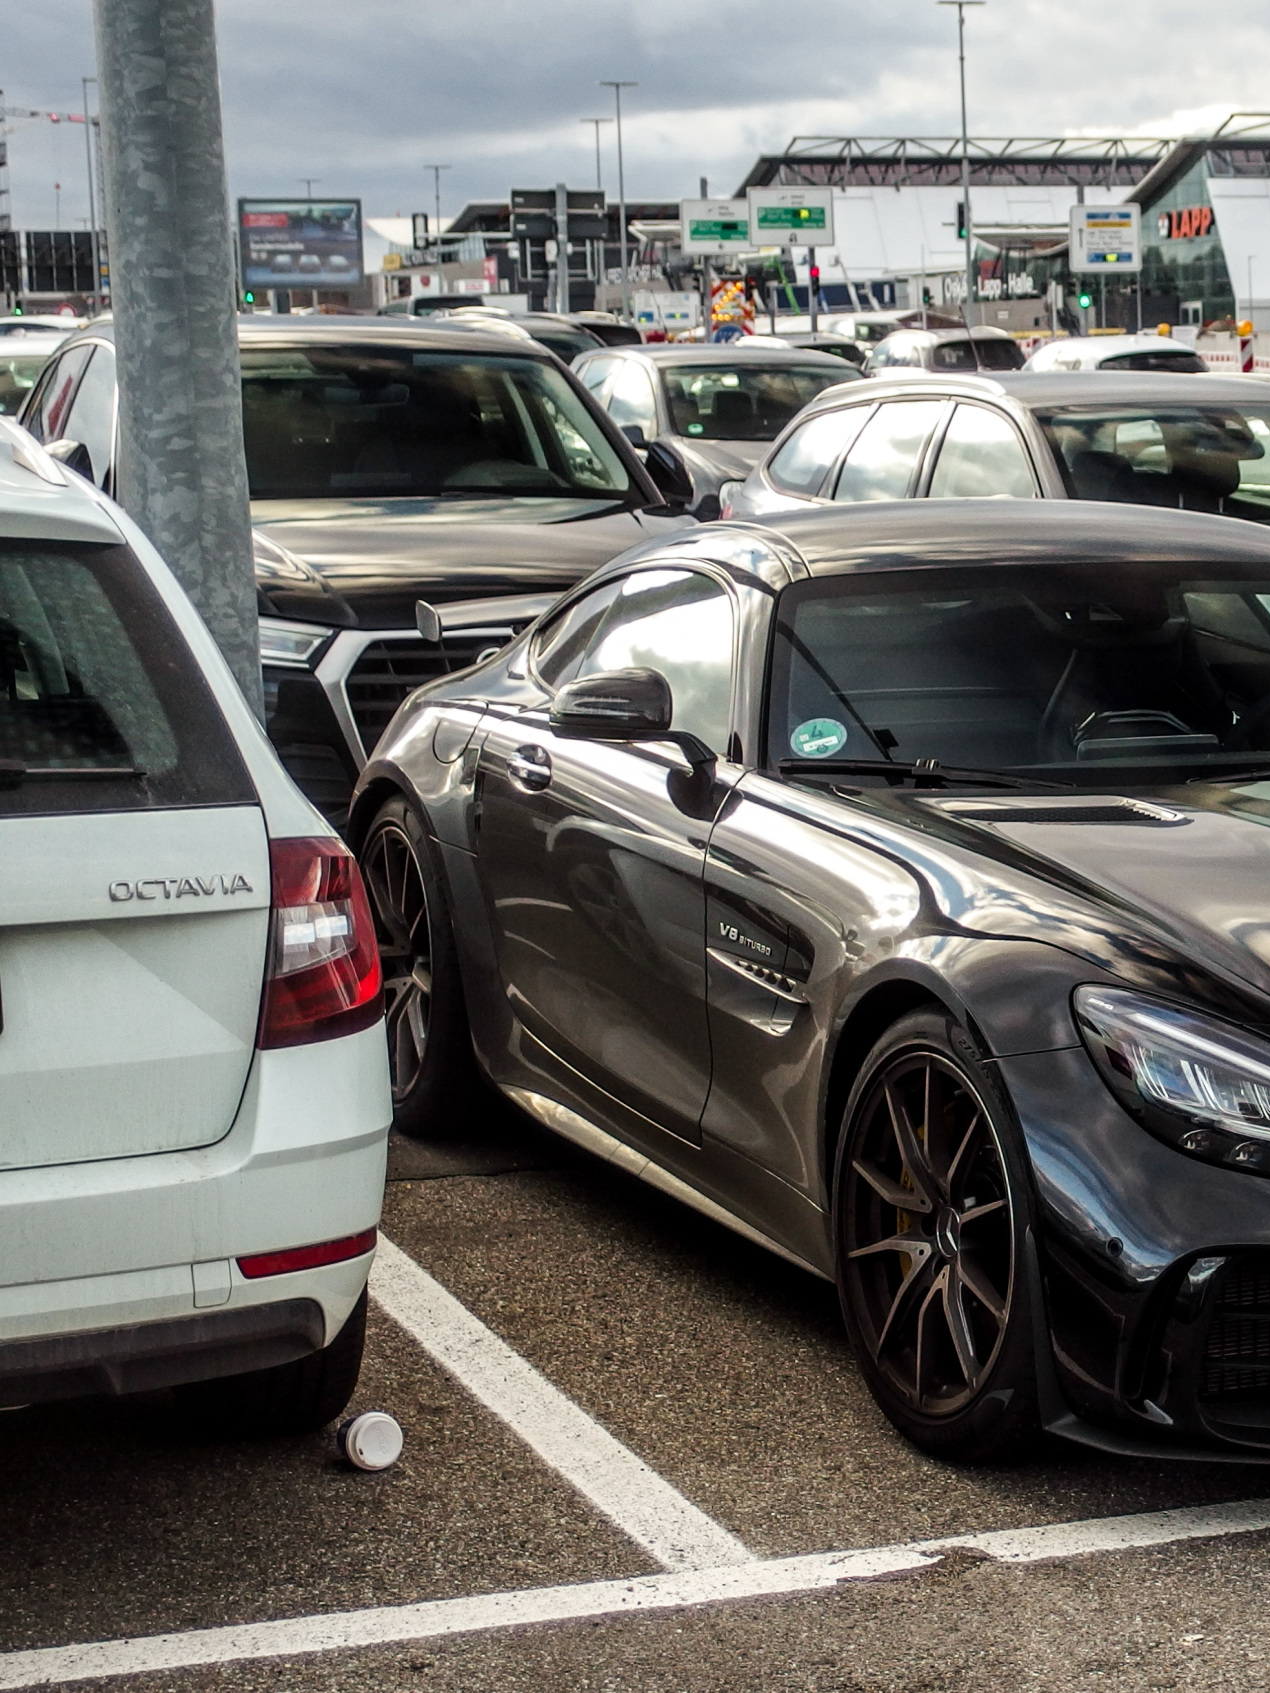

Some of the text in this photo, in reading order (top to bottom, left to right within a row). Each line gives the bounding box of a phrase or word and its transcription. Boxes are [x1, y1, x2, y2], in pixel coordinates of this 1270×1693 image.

[1171, 206, 1212, 240] LAPP
[977, 275, 1002, 301] Lapp
[1007, 271, 1034, 295] Halle
[811, 724, 825, 738] 4
[108, 873, 254, 902] OCTAVIA
[719, 922, 772, 956] V8 BITURBO
